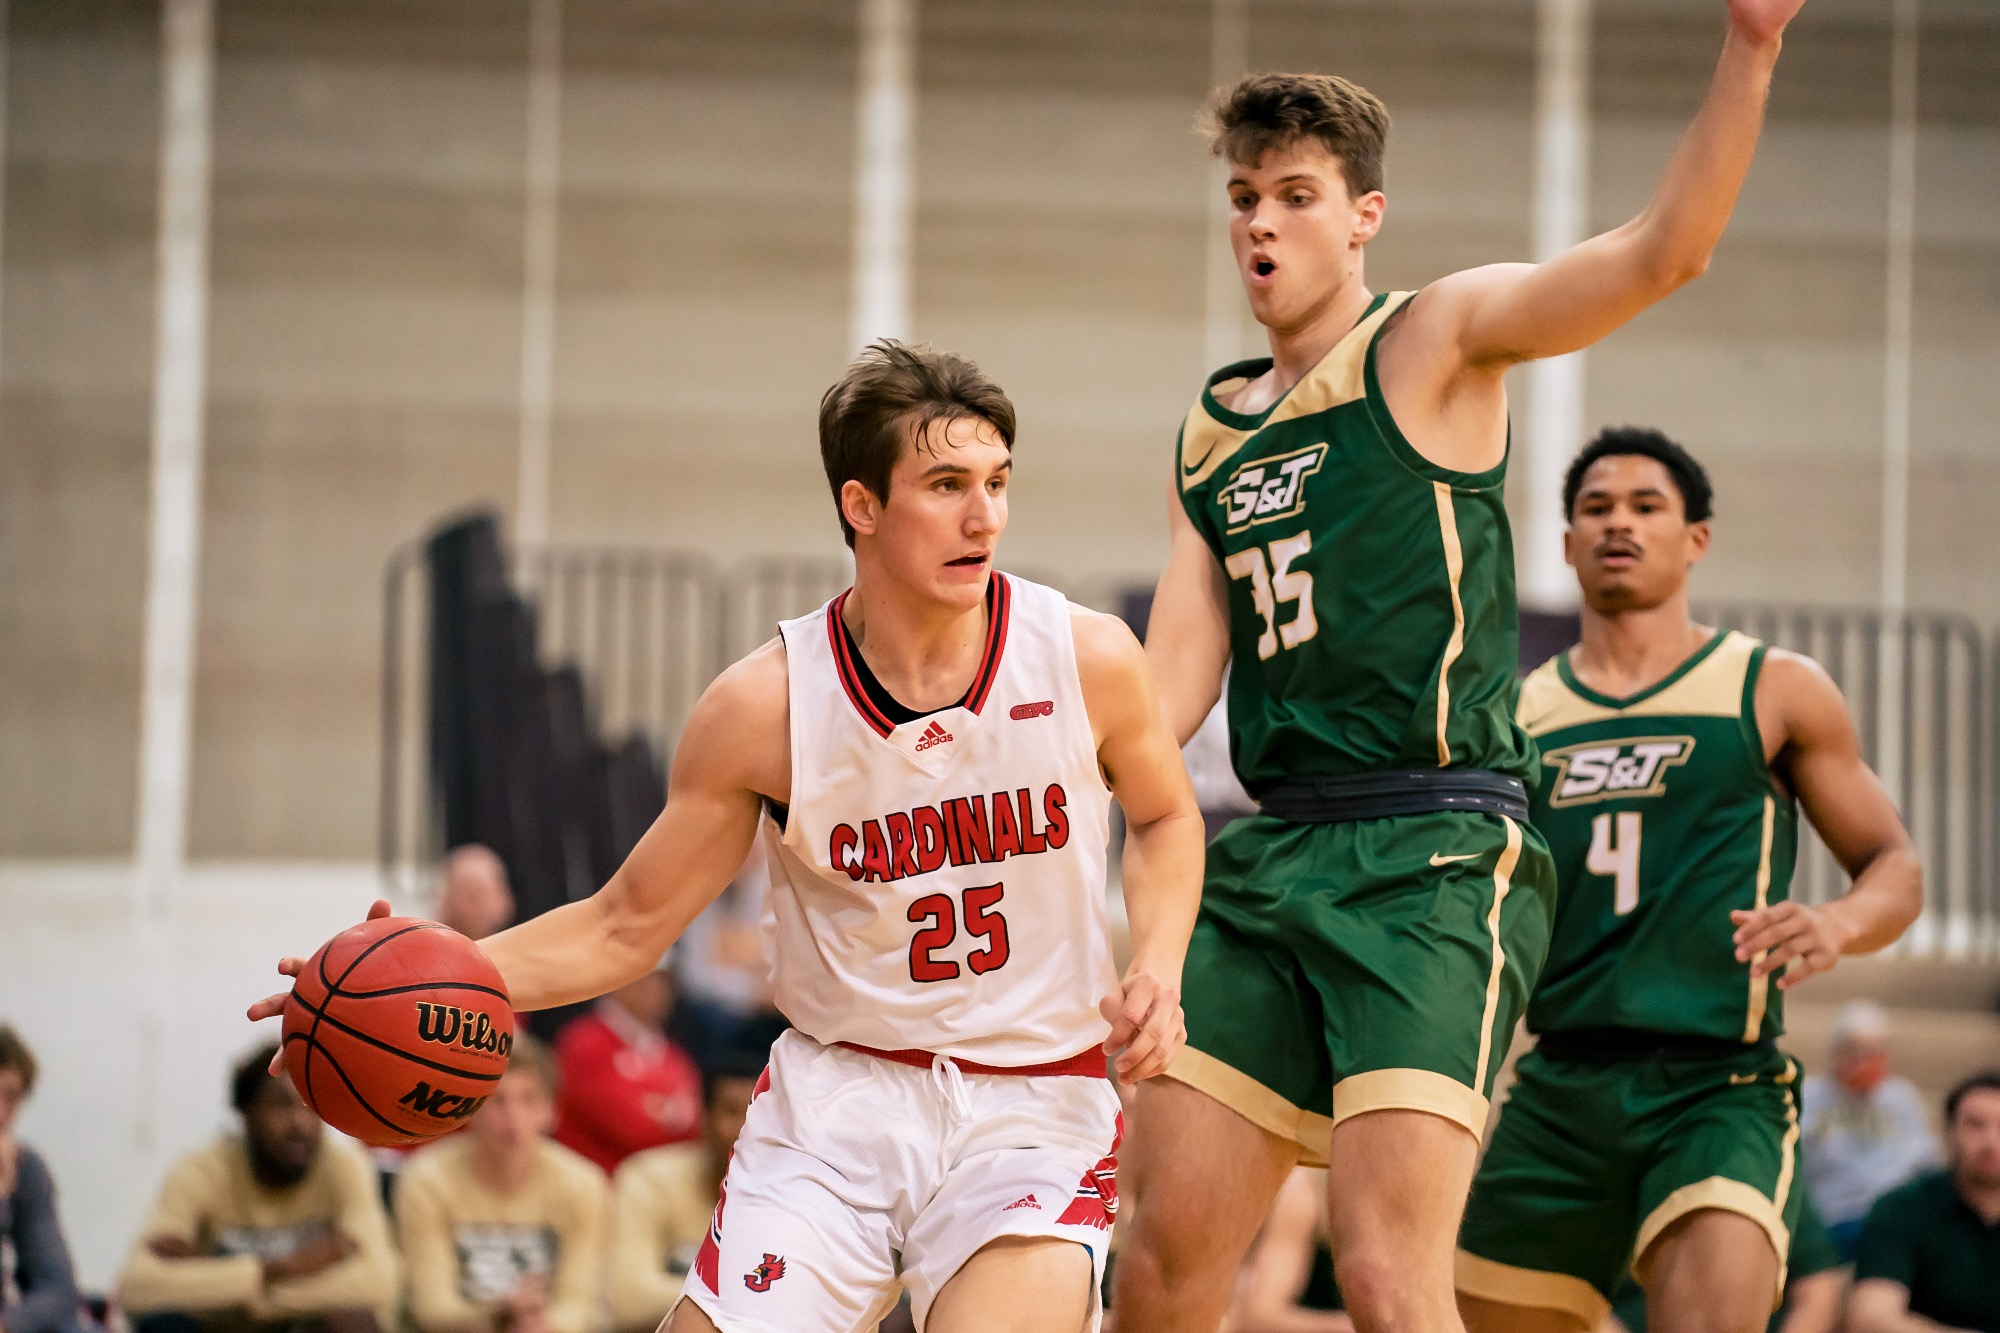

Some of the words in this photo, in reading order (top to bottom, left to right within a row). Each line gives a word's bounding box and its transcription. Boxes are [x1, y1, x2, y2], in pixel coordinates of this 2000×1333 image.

[1225, 450, 1319, 526] S&T
[1225, 529, 1319, 661] 35
[915, 733, 953, 752] adidas
[1557, 741, 1684, 799] S&T
[830, 783, 1070, 883] CARDINALS
[1586, 811, 1642, 916] 4
[907, 882, 1010, 983] 25
